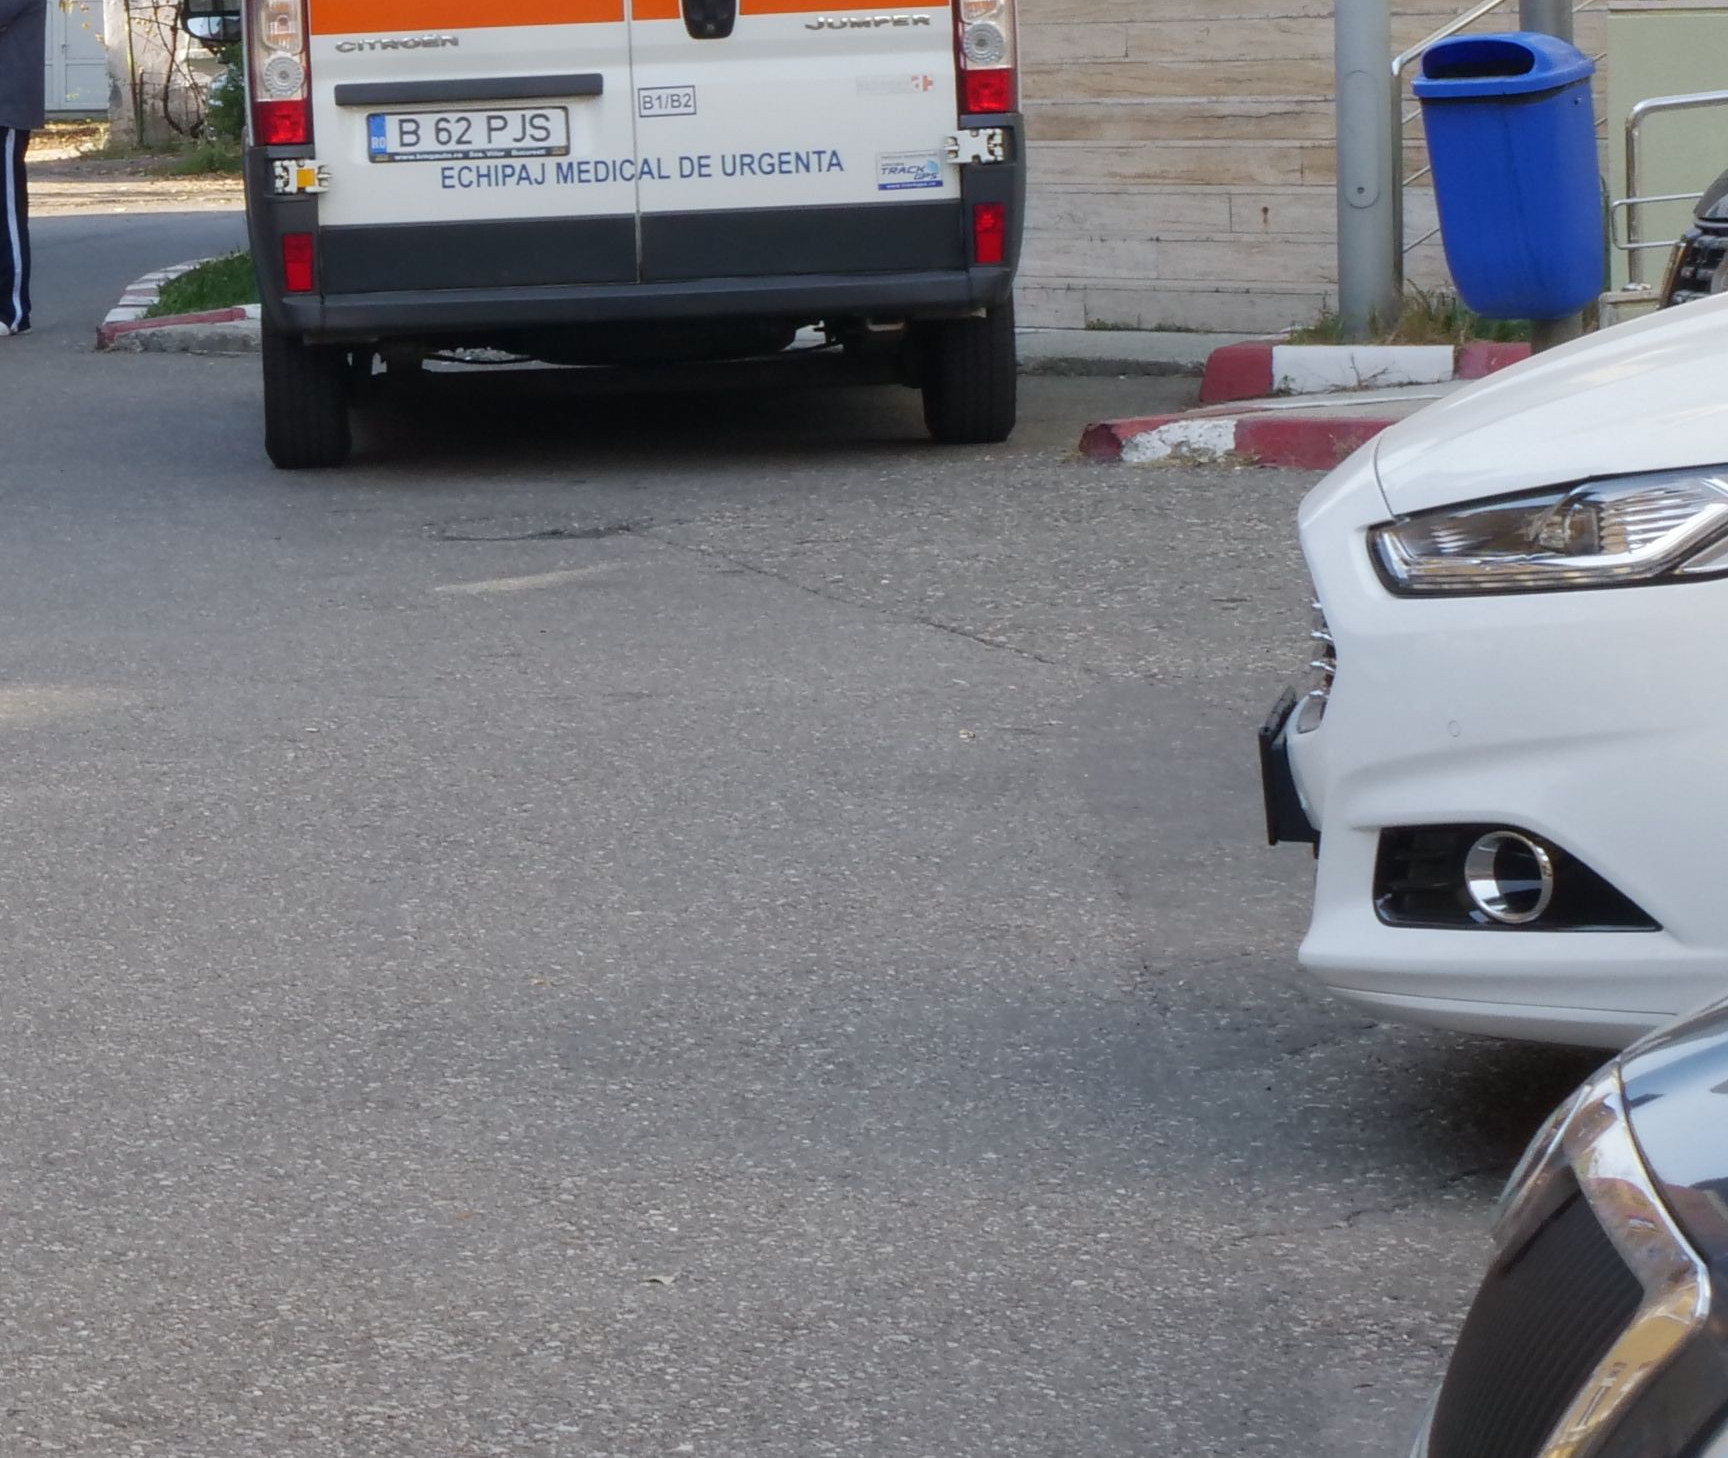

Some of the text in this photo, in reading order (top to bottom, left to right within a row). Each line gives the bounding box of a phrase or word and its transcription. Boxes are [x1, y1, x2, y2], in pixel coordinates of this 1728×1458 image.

[805, 14, 931, 30] JUMPER
[335, 34, 459, 52] CITROËN
[642, 93, 692, 110] B1/B2
[398, 114, 551, 147] B 62 PJS
[441, 150, 844, 189] ECHIPAJ MEDICAL DE URGENTA
